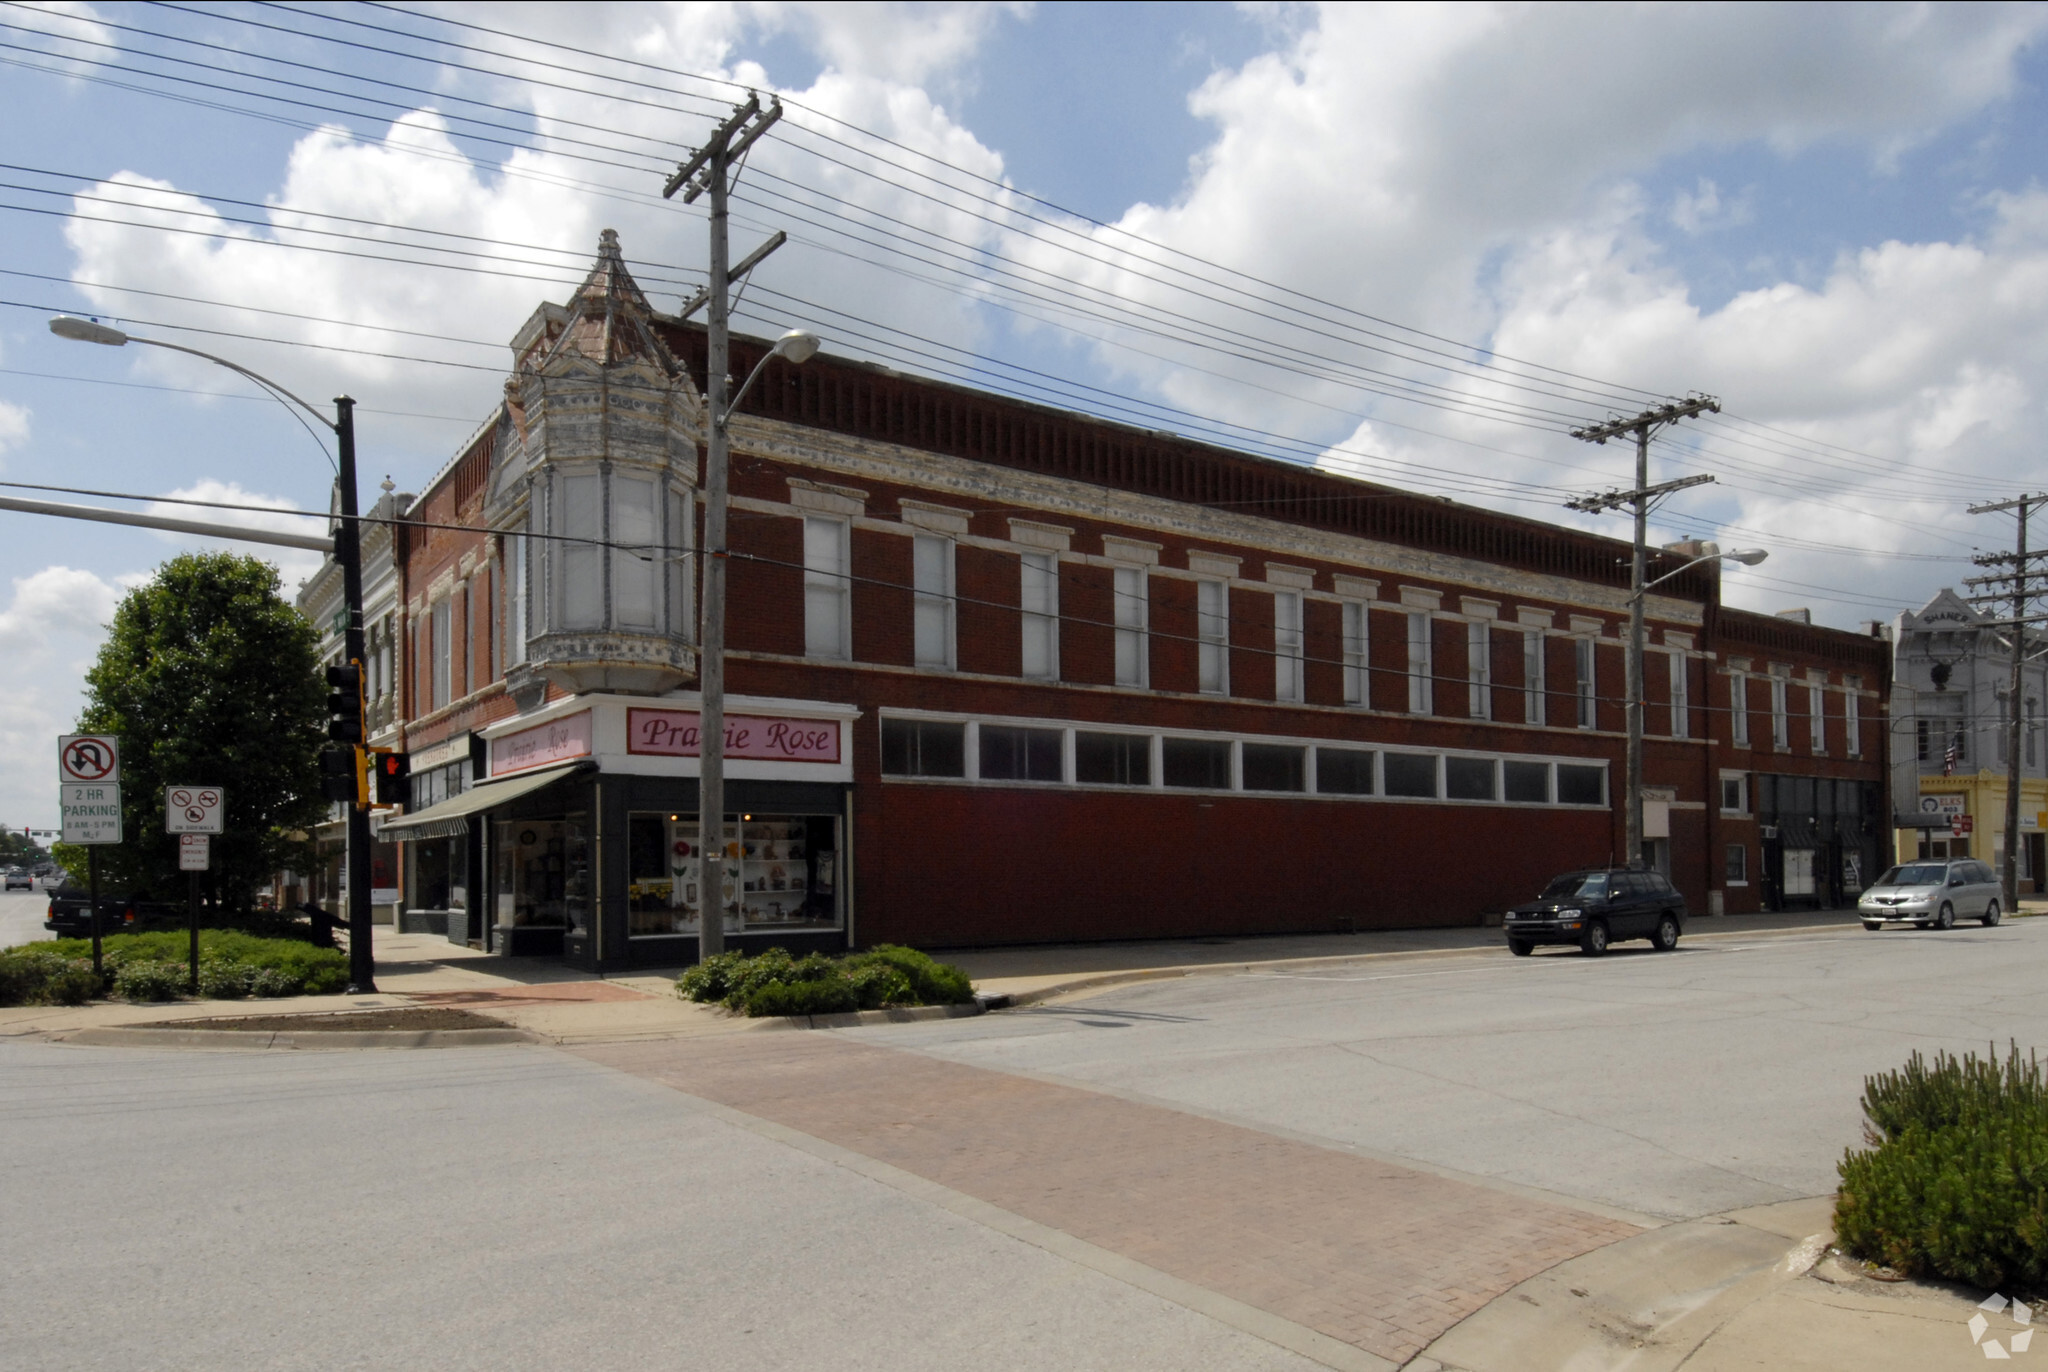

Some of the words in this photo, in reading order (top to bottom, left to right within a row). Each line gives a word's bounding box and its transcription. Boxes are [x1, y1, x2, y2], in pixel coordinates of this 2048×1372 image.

[1924, 611, 1969, 625] SHANER
[547, 725, 569, 757] Rose
[642, 719, 750, 749] Praie
[766, 722, 829, 756] Rose
[75, 789, 83, 800] 2
[87, 788, 104, 800] HR
[1939, 797, 1961, 806] ELKS
[63, 804, 118, 816] PARKING
